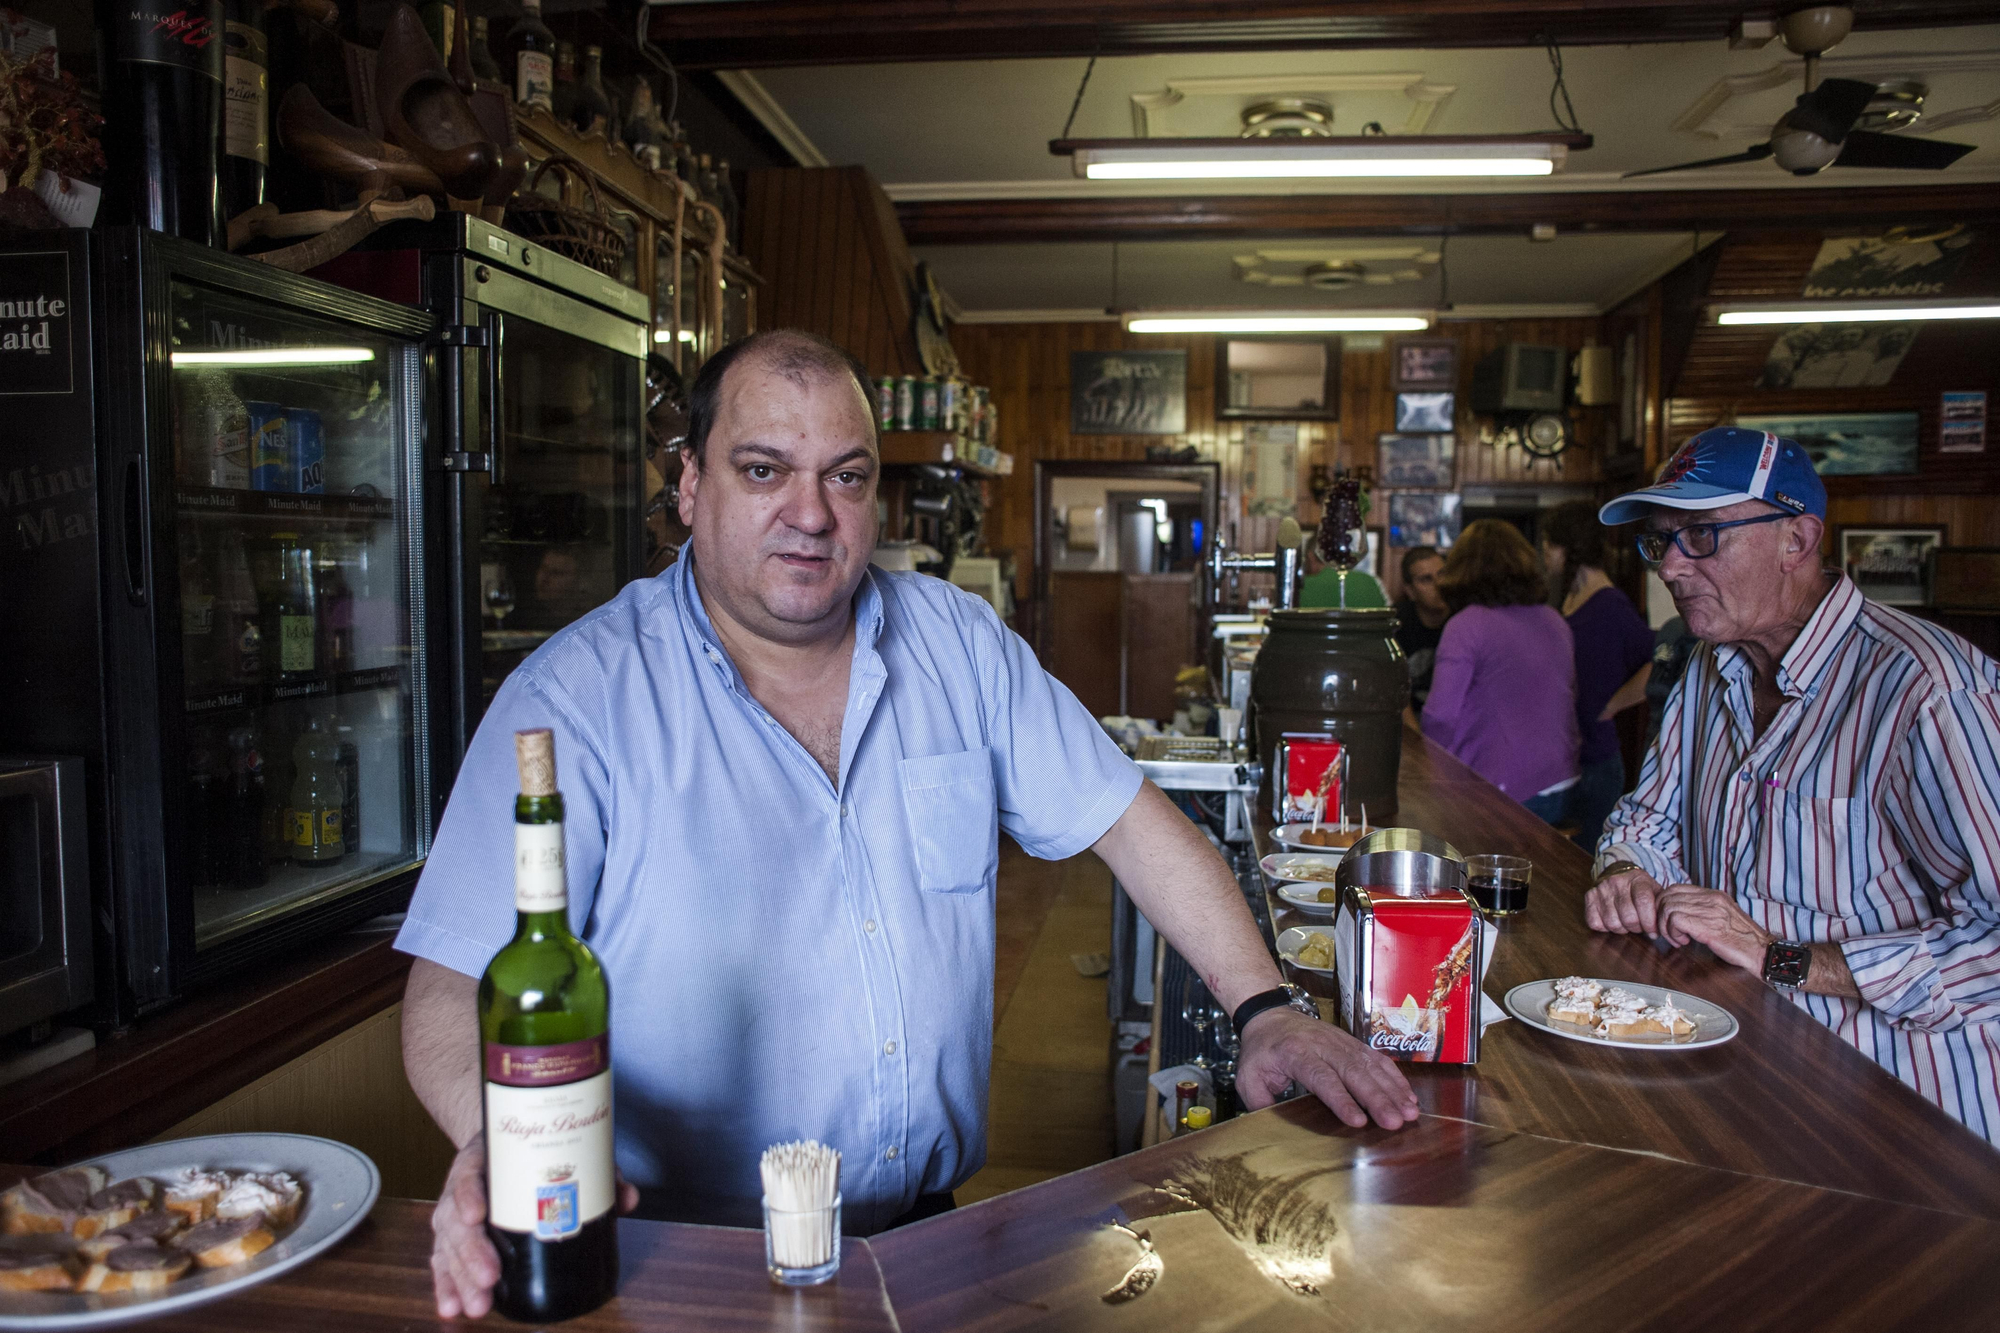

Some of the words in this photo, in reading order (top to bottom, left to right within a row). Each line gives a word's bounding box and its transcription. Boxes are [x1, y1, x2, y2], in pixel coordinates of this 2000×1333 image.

[0, 322, 51, 350] aid
[268, 497, 299, 510] Minute
[300, 499, 322, 512] Maid
[496, 1114, 546, 1140] Rioja
